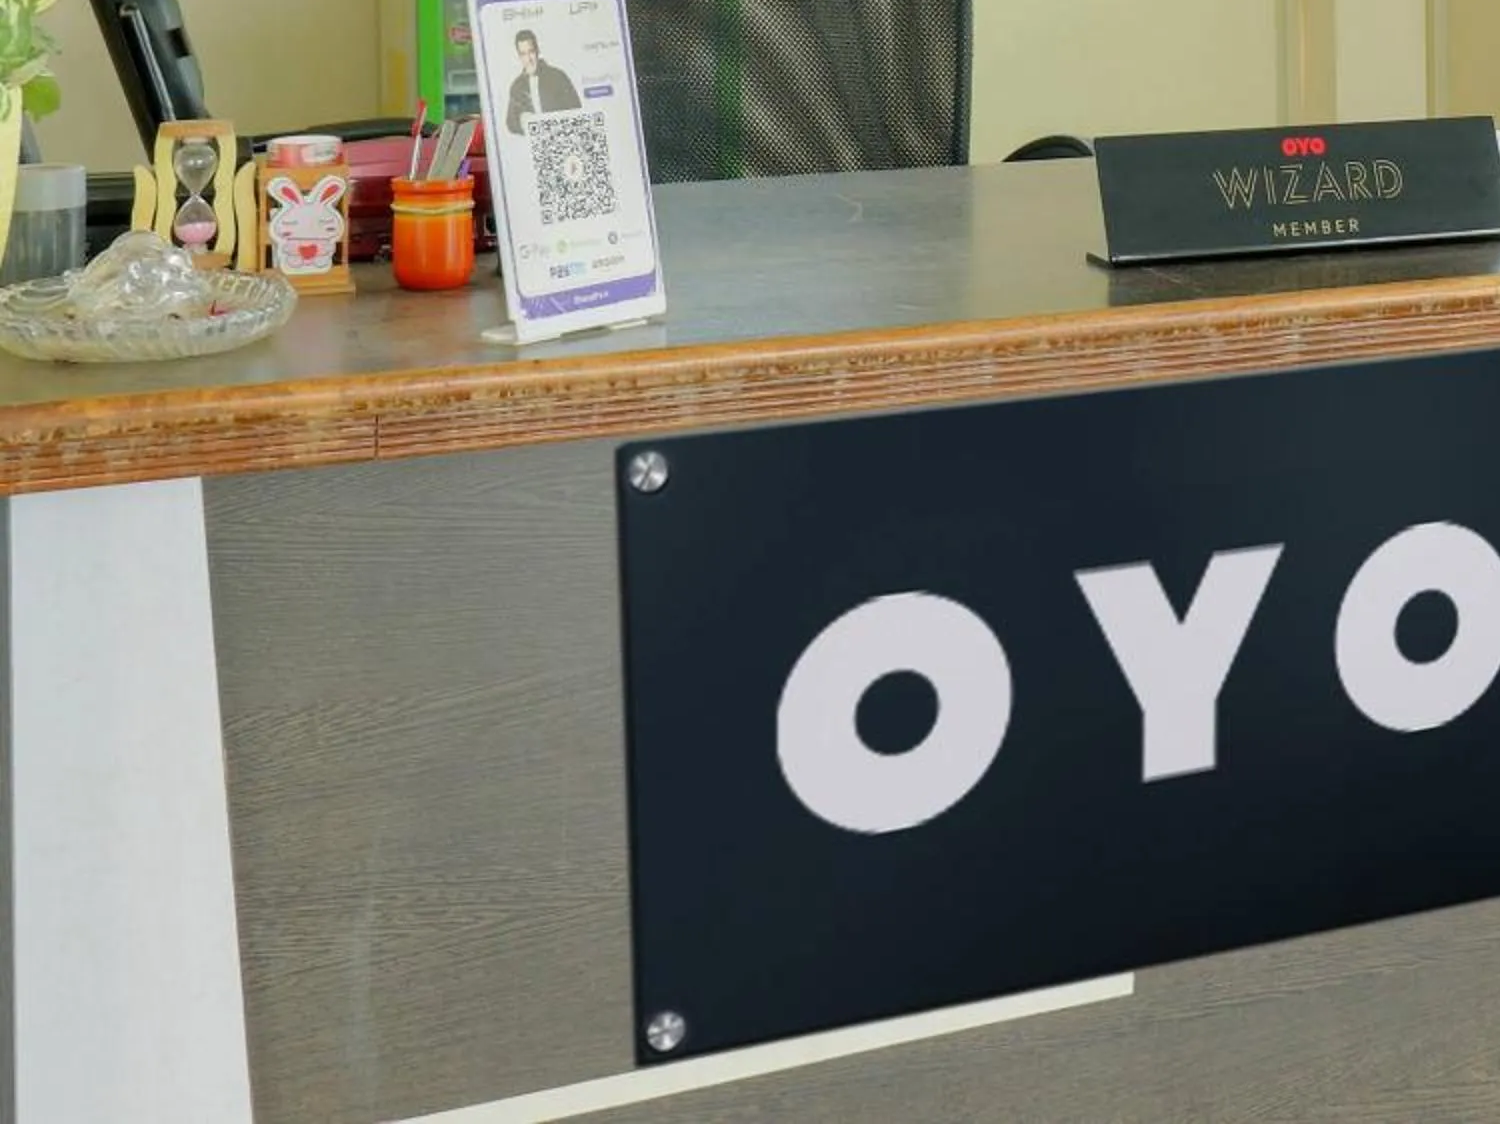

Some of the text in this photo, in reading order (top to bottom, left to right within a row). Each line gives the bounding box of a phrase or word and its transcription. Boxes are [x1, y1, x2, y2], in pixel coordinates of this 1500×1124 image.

[1281, 136, 1326, 157] OYO
[1213, 158, 1403, 210] WIZARD
[1272, 218, 1360, 237] MEMBER
